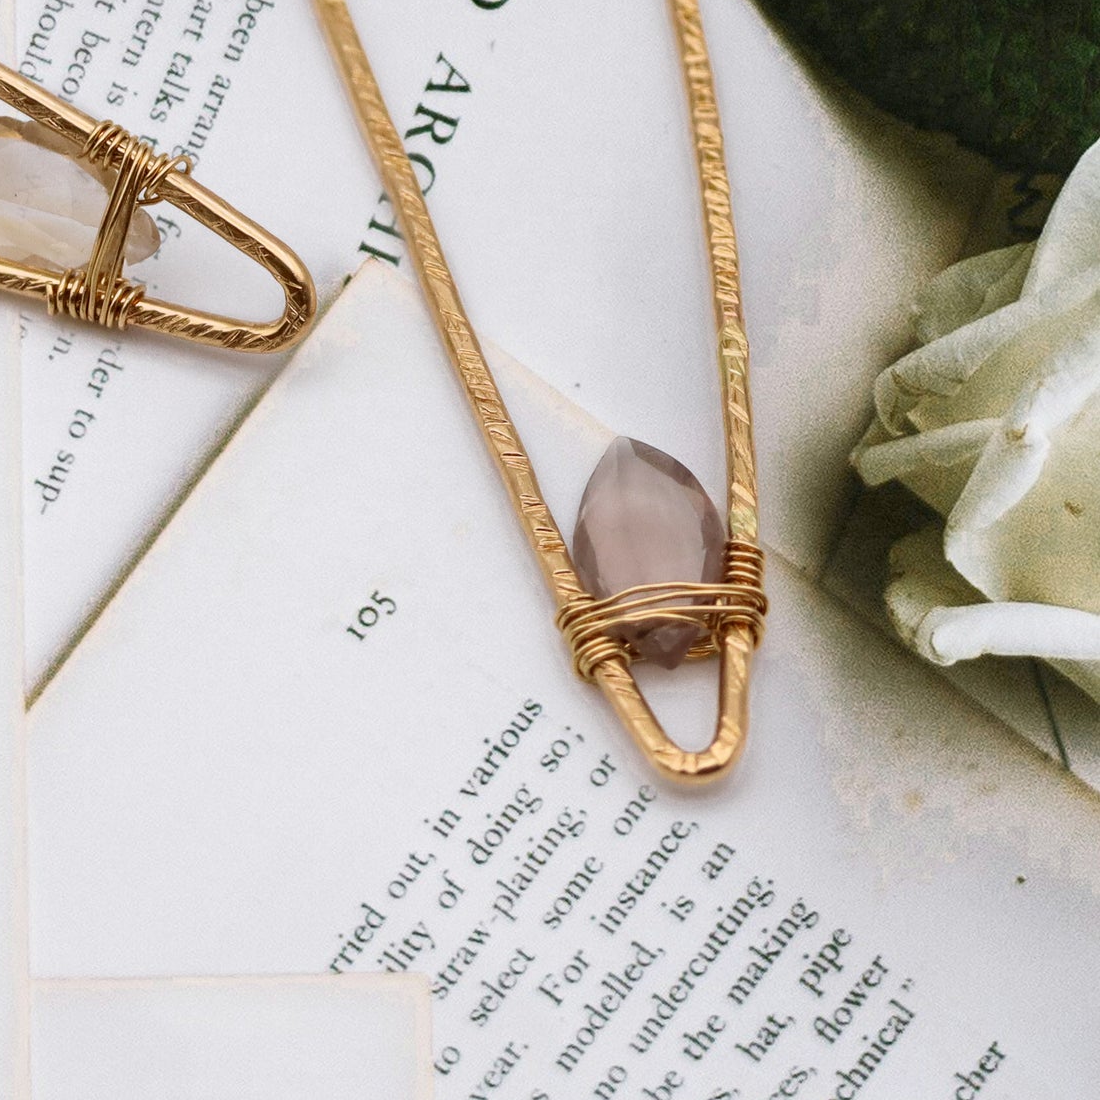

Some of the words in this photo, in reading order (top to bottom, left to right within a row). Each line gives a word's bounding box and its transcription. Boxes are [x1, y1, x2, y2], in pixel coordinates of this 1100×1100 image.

[106, 81, 138, 106] is
[149, 52, 193, 123] talks
[357, 51, 472, 267] ARCHI
[68, 409, 96, 439] to
[346, 589, 397, 642] 105
[387, 853, 437, 900] out,
[423, 809, 462, 839] in
[458, 698, 543, 797] various
[438, 869, 465, 910] of
[466, 783, 543, 866] doing
[539, 726, 585, 773] so;
[589, 754, 617, 787] or
[433, 1046, 461, 1076] to
[469, 948, 536, 1028] select
[542, 856, 604, 930] some
[613, 785, 657, 837] one
[536, 949, 591, 1007] For
[590, 821, 699, 936] instance,
[555, 940, 666, 1074] modelled,
[660, 895, 696, 923] is
[701, 843, 736, 881] an
[628, 876, 776, 1054] undercutting.
[682, 1015, 726, 1062] the
[726, 897, 820, 1006] making
[734, 1014, 796, 1063] hat,
[798, 928, 852, 999] pipe
[812, 954, 889, 1045] flower
